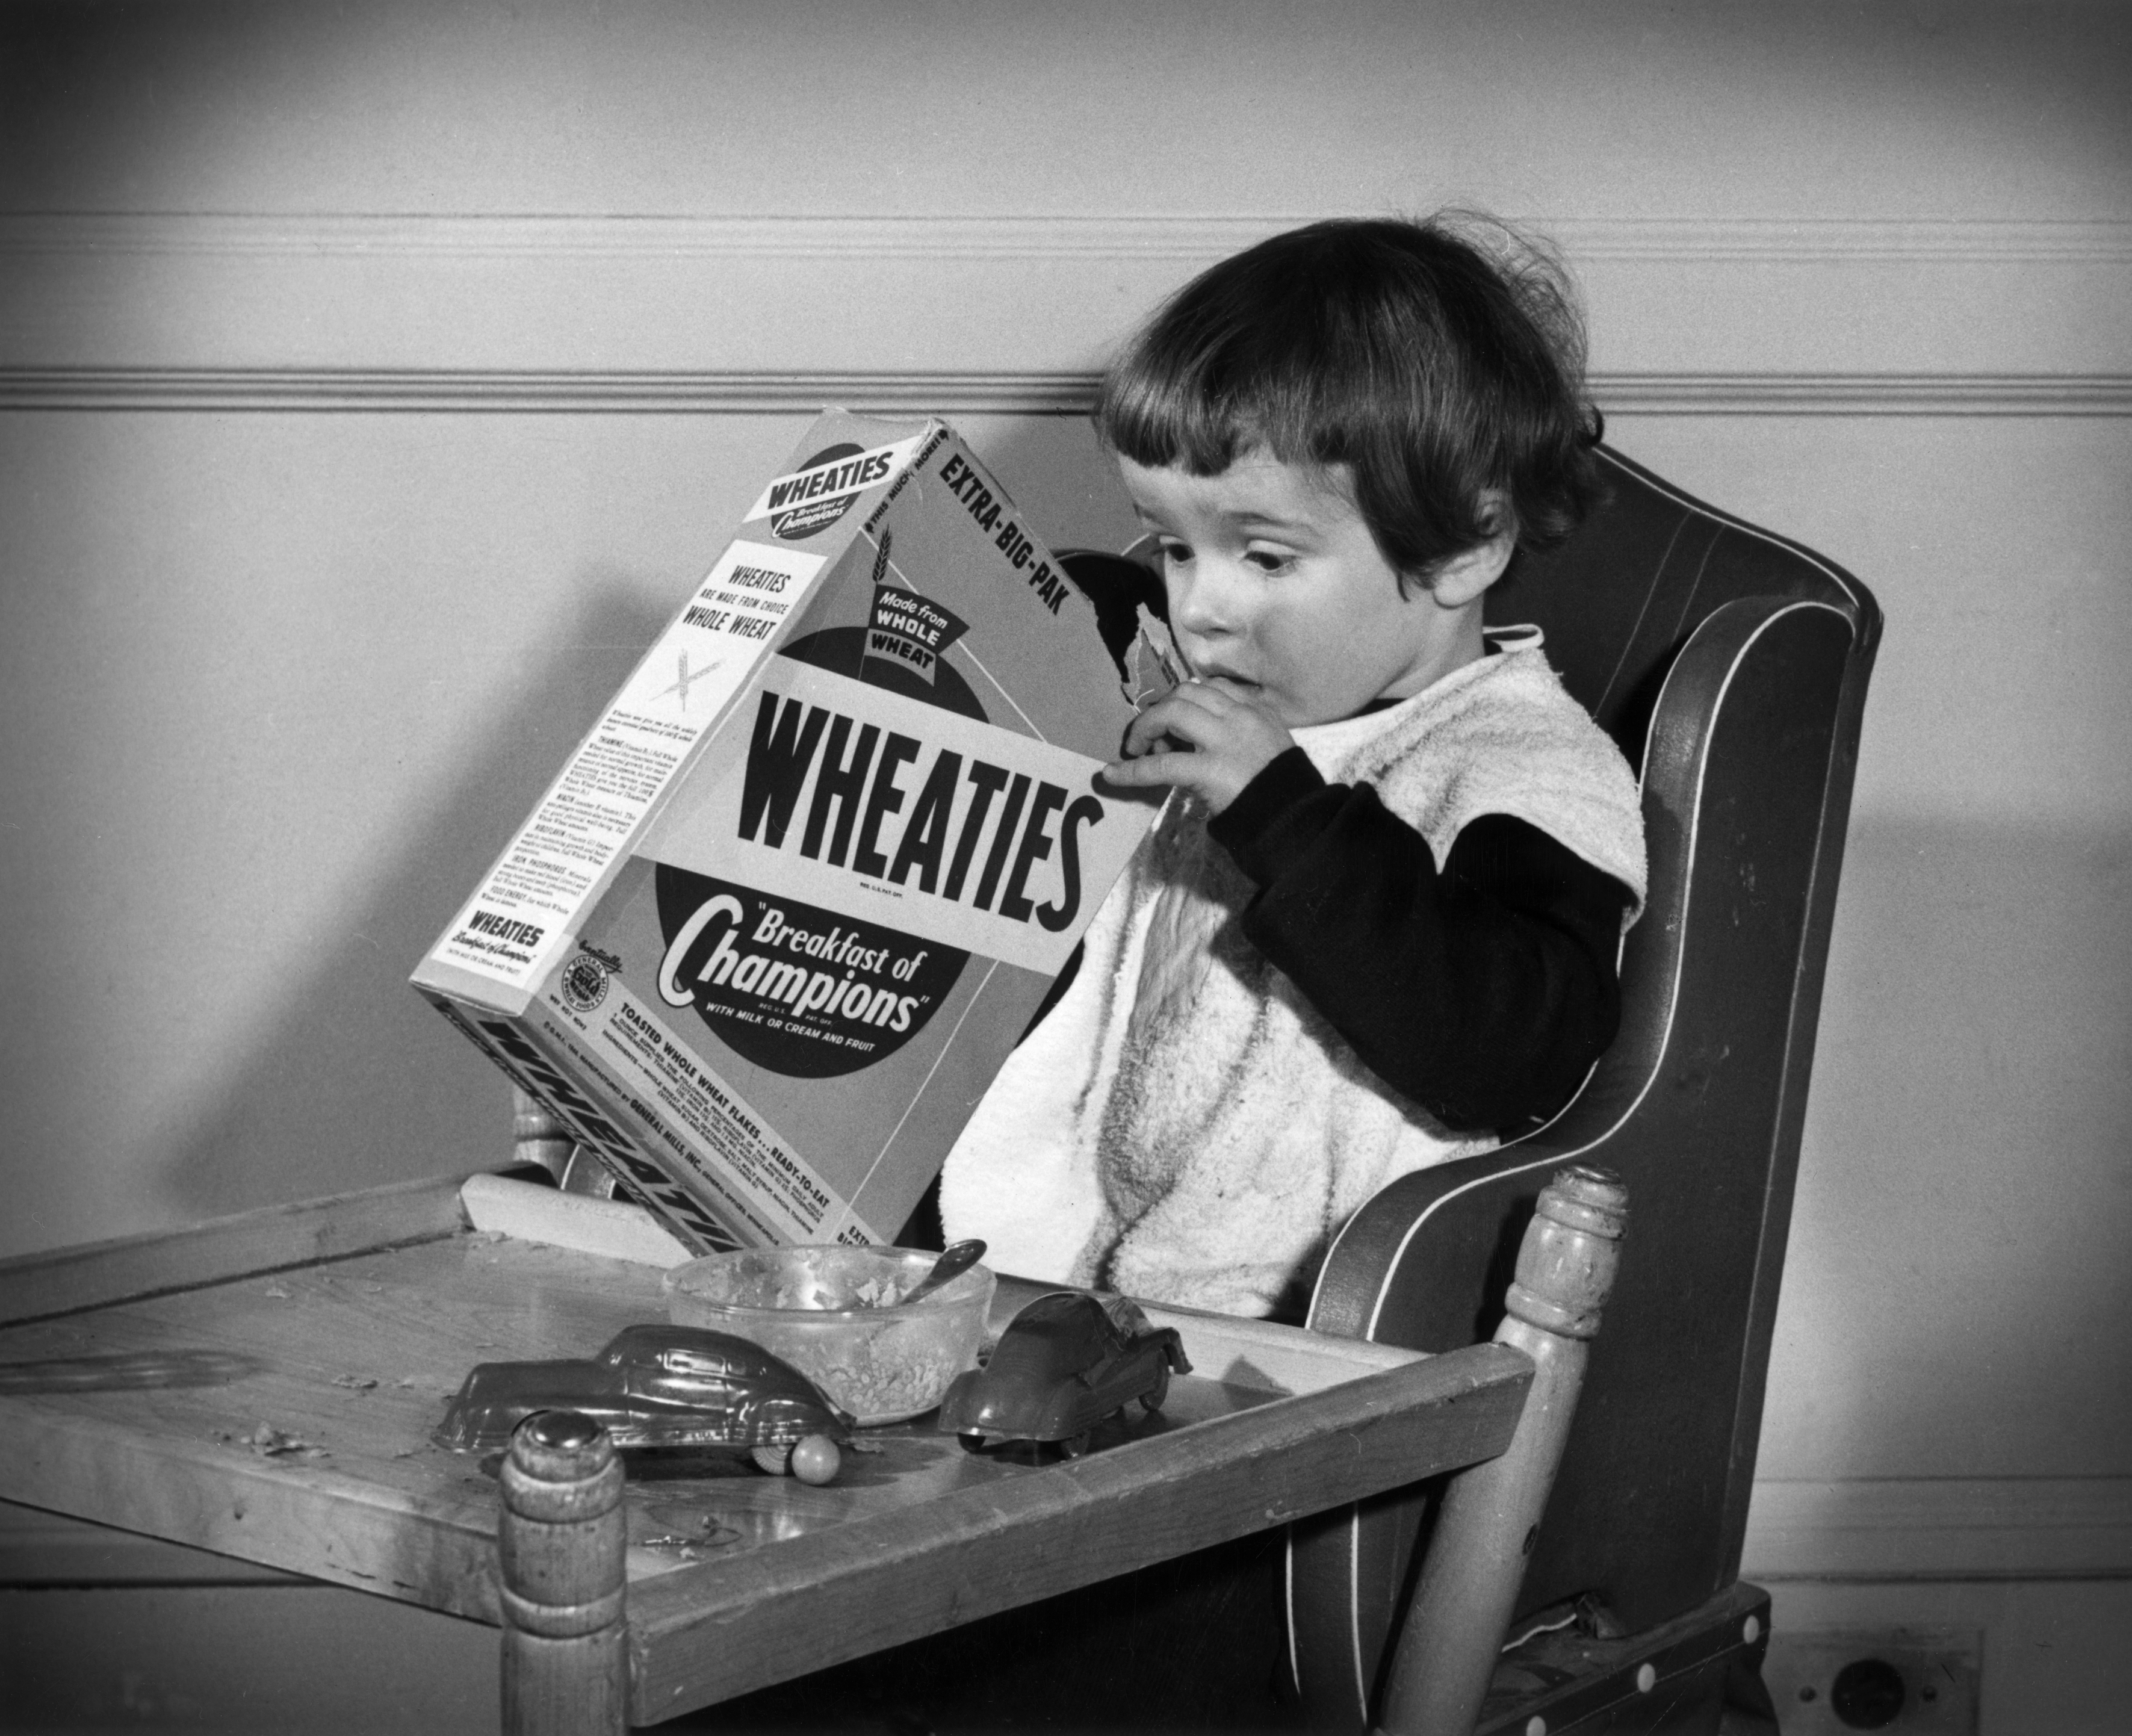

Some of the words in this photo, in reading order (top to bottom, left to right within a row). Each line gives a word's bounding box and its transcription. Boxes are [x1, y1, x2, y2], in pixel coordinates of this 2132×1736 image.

[768, 451, 894, 510] WHEATIES
[872, 501, 889, 525] THIS
[888, 471, 914, 501] MUCH
[914, 438, 941, 471] MORE!
[939, 453, 1070, 616] EXTRA-BIG-PAK
[728, 565, 791, 593] WHEATIES
[683, 605, 730, 631] WHOLE
[728, 615, 777, 640] WHEAT
[699, 588, 717, 600] ARE
[716, 591, 739, 604] MADE
[738, 595, 760, 609] FROM
[760, 601, 789, 615] CHOICE
[879, 591, 917, 613] Made
[918, 605, 948, 629] from
[877, 609, 941, 646] WHOLE
[872, 633, 934, 669] WHEAT
[738, 690, 1105, 932] WHEATIES
[491, 886, 505, 895] FOOD
[469, 911, 544, 947] WHEATIES
[752, 901, 889, 974] "Breakfast
[891, 950, 928, 982] of
[572, 966, 601, 997] Gold
[573, 957, 603, 972] GENERAL
[659, 894, 930, 1032] Champions"
[561, 1006, 572, 1016] NOT
[705, 1002, 734, 1018] WITH
[735, 1009, 764, 1024] MILK
[767, 1018, 783, 1029] OR
[784, 1022, 822, 1038] CREAM
[822, 1032, 843, 1044] AND
[845, 1037, 876, 1052] FRUIT
[621, 1002, 662, 1044] TOASTED
[664, 1042, 697, 1077] WHOLE
[698, 1074, 729, 1108] WHEAT
[478, 1020, 744, 1254] WHEATI
[619, 1018, 638, 1040] OUNCE
[640, 1038, 665, 1062] SUPPLIES
[667, 1062, 678, 1074] THE
[680, 1075, 709, 1105] FOLLOWING
[711, 1105, 745, 1140] PERCENTAGES
[757, 1150, 766, 1161] THE
[768, 1162, 790, 1185] MINIMUM
[792, 1185, 807, 1200] DAILY
[808, 1202, 824, 1217] ADULT
[686, 1099, 699, 1112] IRON
[710, 1122, 721, 1133] AND
[535, 1097, 593, 1146] WHOLE
[597, 1153, 652, 1204] WHEAT
[580, 1055, 621, 1095] MANUFACTURED
[630, 1099, 663, 1134] GENERAL
[663, 1130, 685, 1156] MILLS,
[702, 1171, 724, 1194] GENERAL
[747, 1214, 779, 1246] MINNEAPOLIS
[654, 1059, 680, 1083] THIAMINE
[723, 1126, 751, 1155] RIBOFLAVIN
[790, 1192, 820, 1223] PHOSPHORUS
[689, 1121, 700, 1132] AND
[700, 1128, 729, 1160] RIBOFLAVIN
[742, 1163, 755, 1176] MALT
[791, 1211, 814, 1235] THIAMINE
[849, 1226, 869, 1244] EXTR
